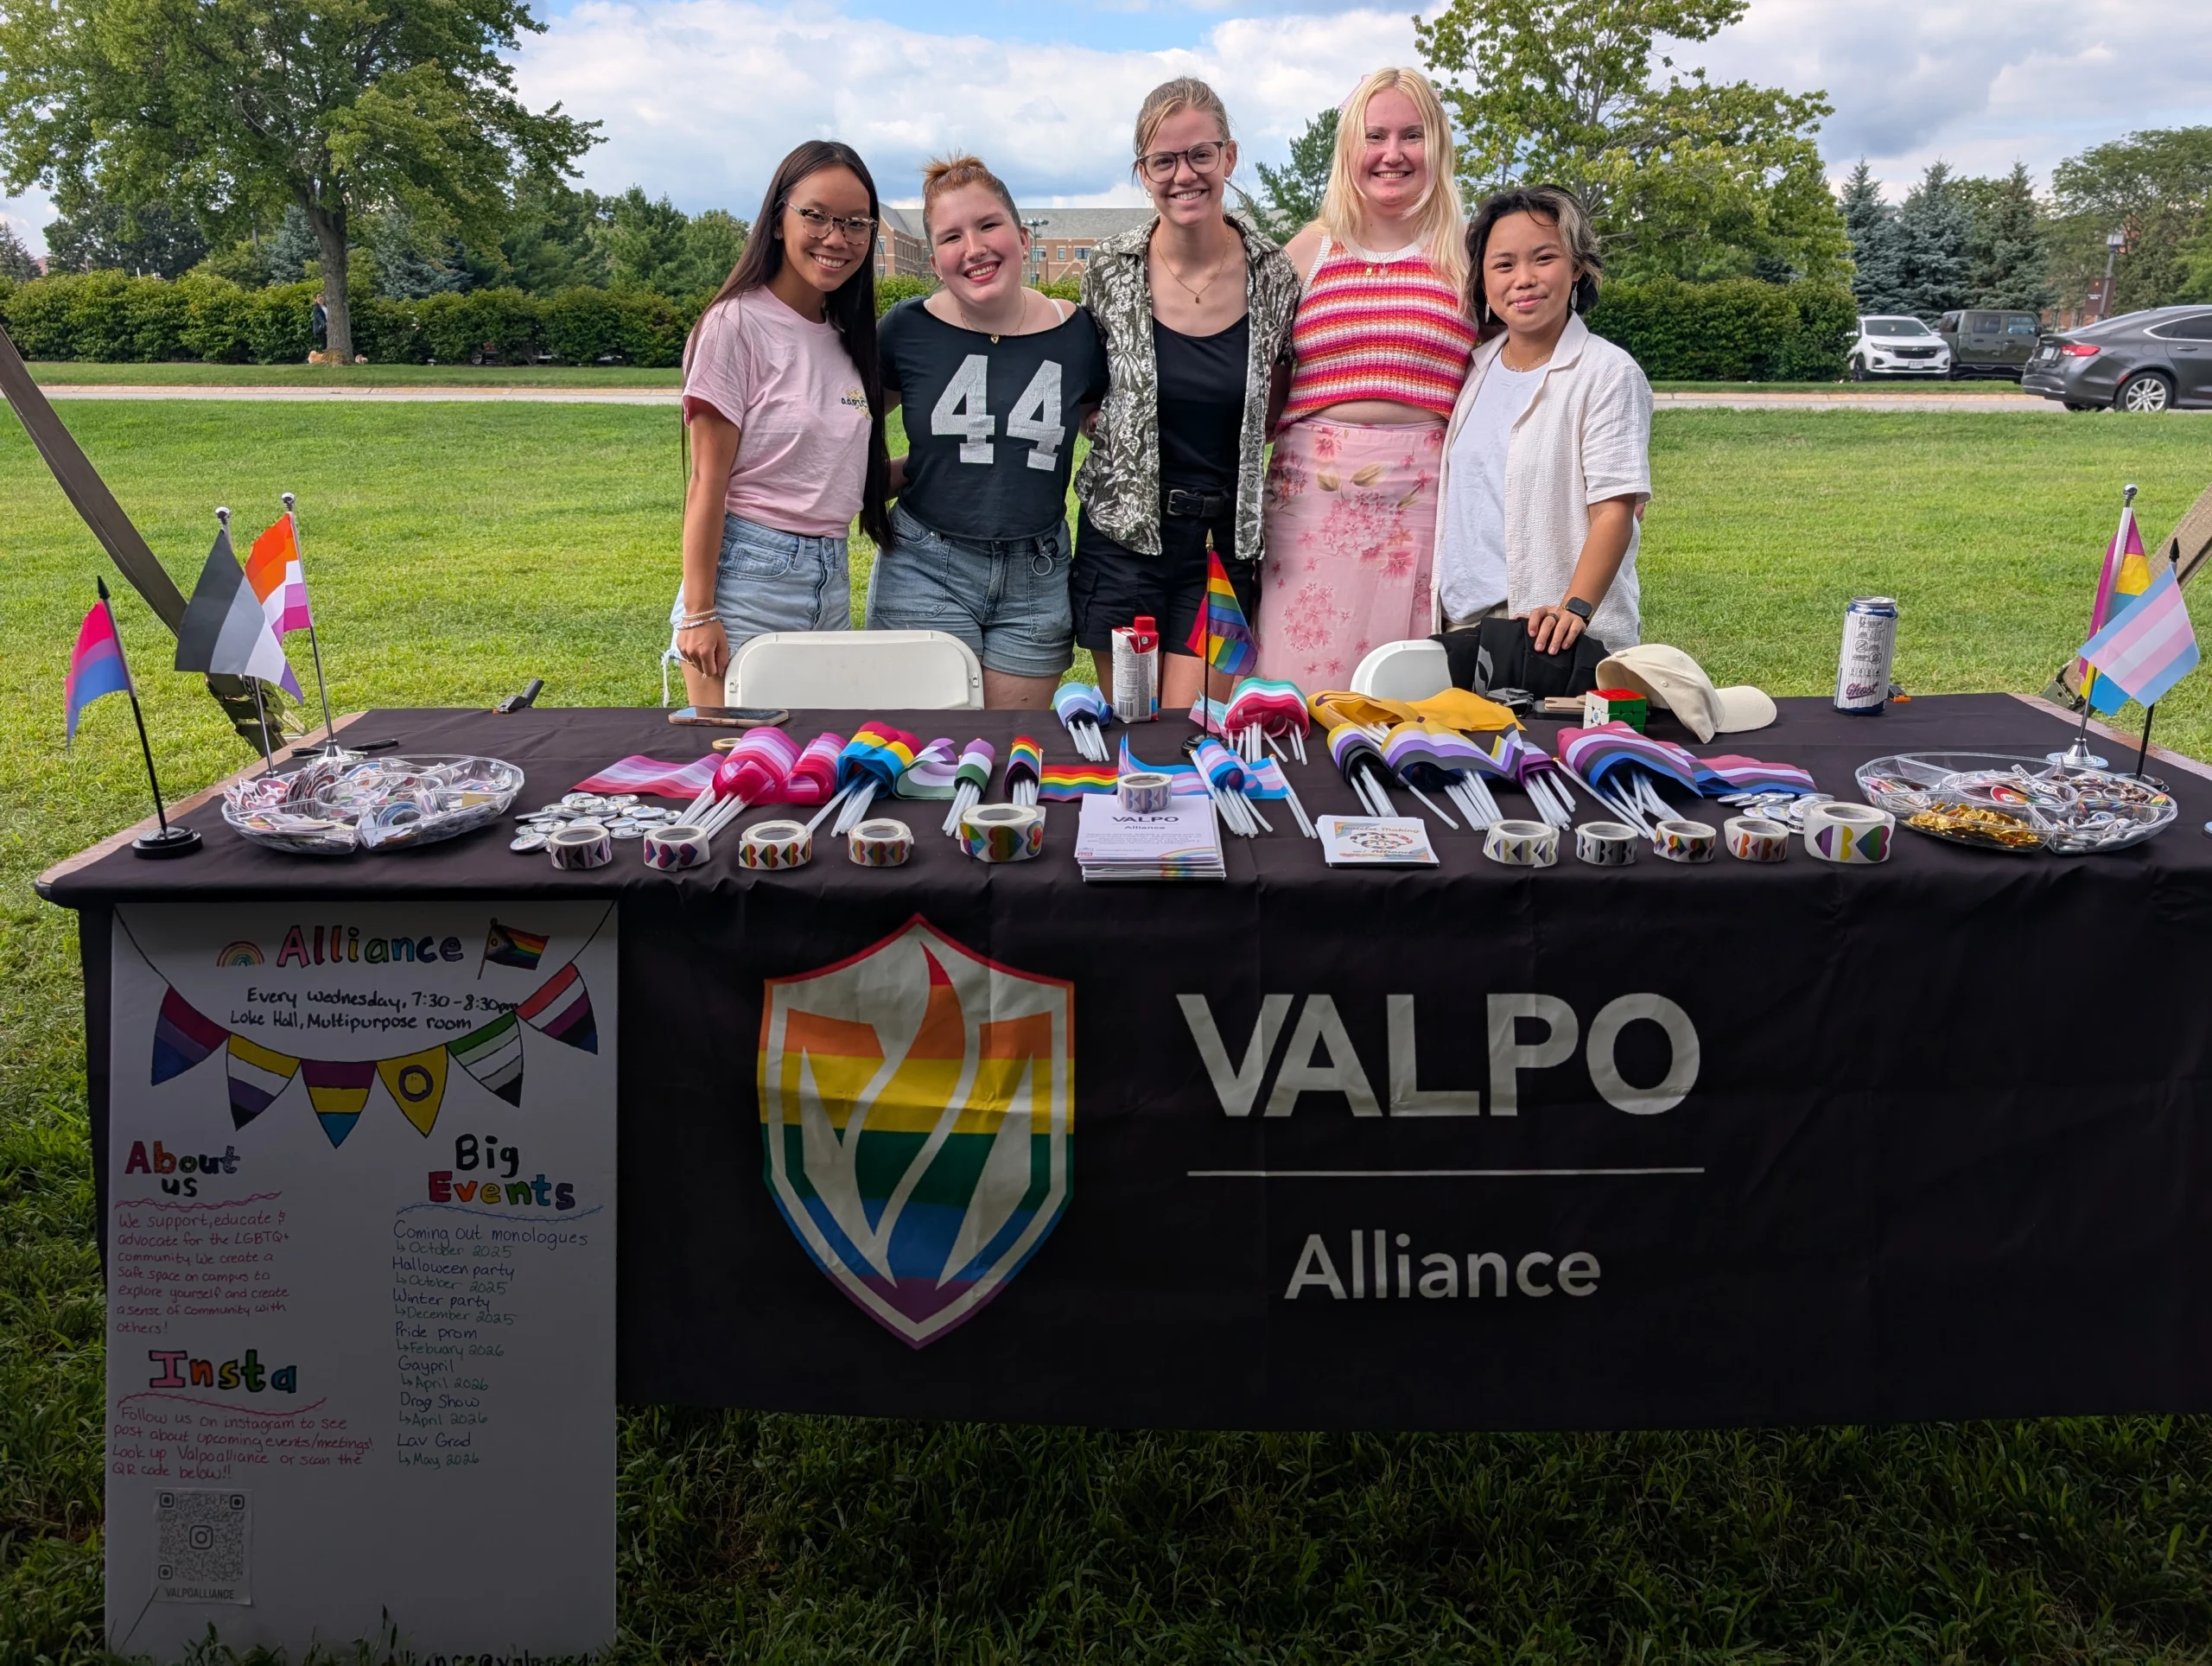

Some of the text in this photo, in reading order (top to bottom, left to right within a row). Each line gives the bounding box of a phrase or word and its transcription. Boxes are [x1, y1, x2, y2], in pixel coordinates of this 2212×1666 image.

[931, 354, 1065, 471] 44
[1846, 682, 1879, 696] Ghost
[2013, 766, 2037, 785] PRIDE
[276, 925, 465, 969] Alliance
[247, 987, 296, 1008] Every
[427, 1018, 471, 1030] room
[1176, 993, 1700, 1117] VALPO
[125, 1141, 240, 1174] About
[455, 1133, 519, 1179] Big
[162, 1178, 198, 1197] us
[429, 1171, 576, 1211] Events
[119, 1212, 140, 1229] We
[118, 1230, 289, 1247] advocate for the LGBTQ+
[393, 1220, 588, 1250] Coming out monologues
[196, 1253, 214, 1265] We
[220, 1252, 259, 1263] create
[264, 1253, 273, 1262] a
[410, 1242, 514, 1258] October 2025
[392, 1256, 514, 1281] Halloween party
[1284, 1229, 1600, 1300] Alliance
[148, 1269, 181, 1283] space
[185, 1272, 199, 1281] on
[202, 1272, 248, 1284] campus
[255, 1270, 270, 1281] to
[410, 1275, 508, 1294] October 2025
[118, 1285, 289, 1303] explore yourself and create
[393, 1288, 491, 1312] Winter party
[117, 1303, 286, 1317] a sense of community with
[408, 1307, 518, 1326] December 2025
[117, 1321, 168, 1334] others!
[396, 1321, 477, 1341] Pride prom
[410, 1342, 505, 1360] Febuary 2026
[149, 1349, 296, 1394] Insta
[398, 1355, 454, 1376] Gaypril
[416, 1376, 488, 1392] April 2026
[401, 1391, 480, 1412] Drag Show
[122, 1407, 347, 1434] Follow us on instagram to see
[412, 1413, 488, 1428] April 2026
[114, 1425, 143, 1438] post
[150, 1429, 190, 1442] about
[197, 1434, 264, 1453] upcoming
[397, 1432, 471, 1447] Lav Grad
[113, 1445, 144, 1459] Look
[151, 1449, 167, 1461] up
[280, 1454, 295, 1465] or
[301, 1456, 330, 1466] scan
[338, 1454, 362, 1466] the
[413, 1452, 480, 1469] May 2026
[113, 1462, 232, 1480] QR code below!!
[166, 1587, 235, 1600] VALPOALLIANCE
